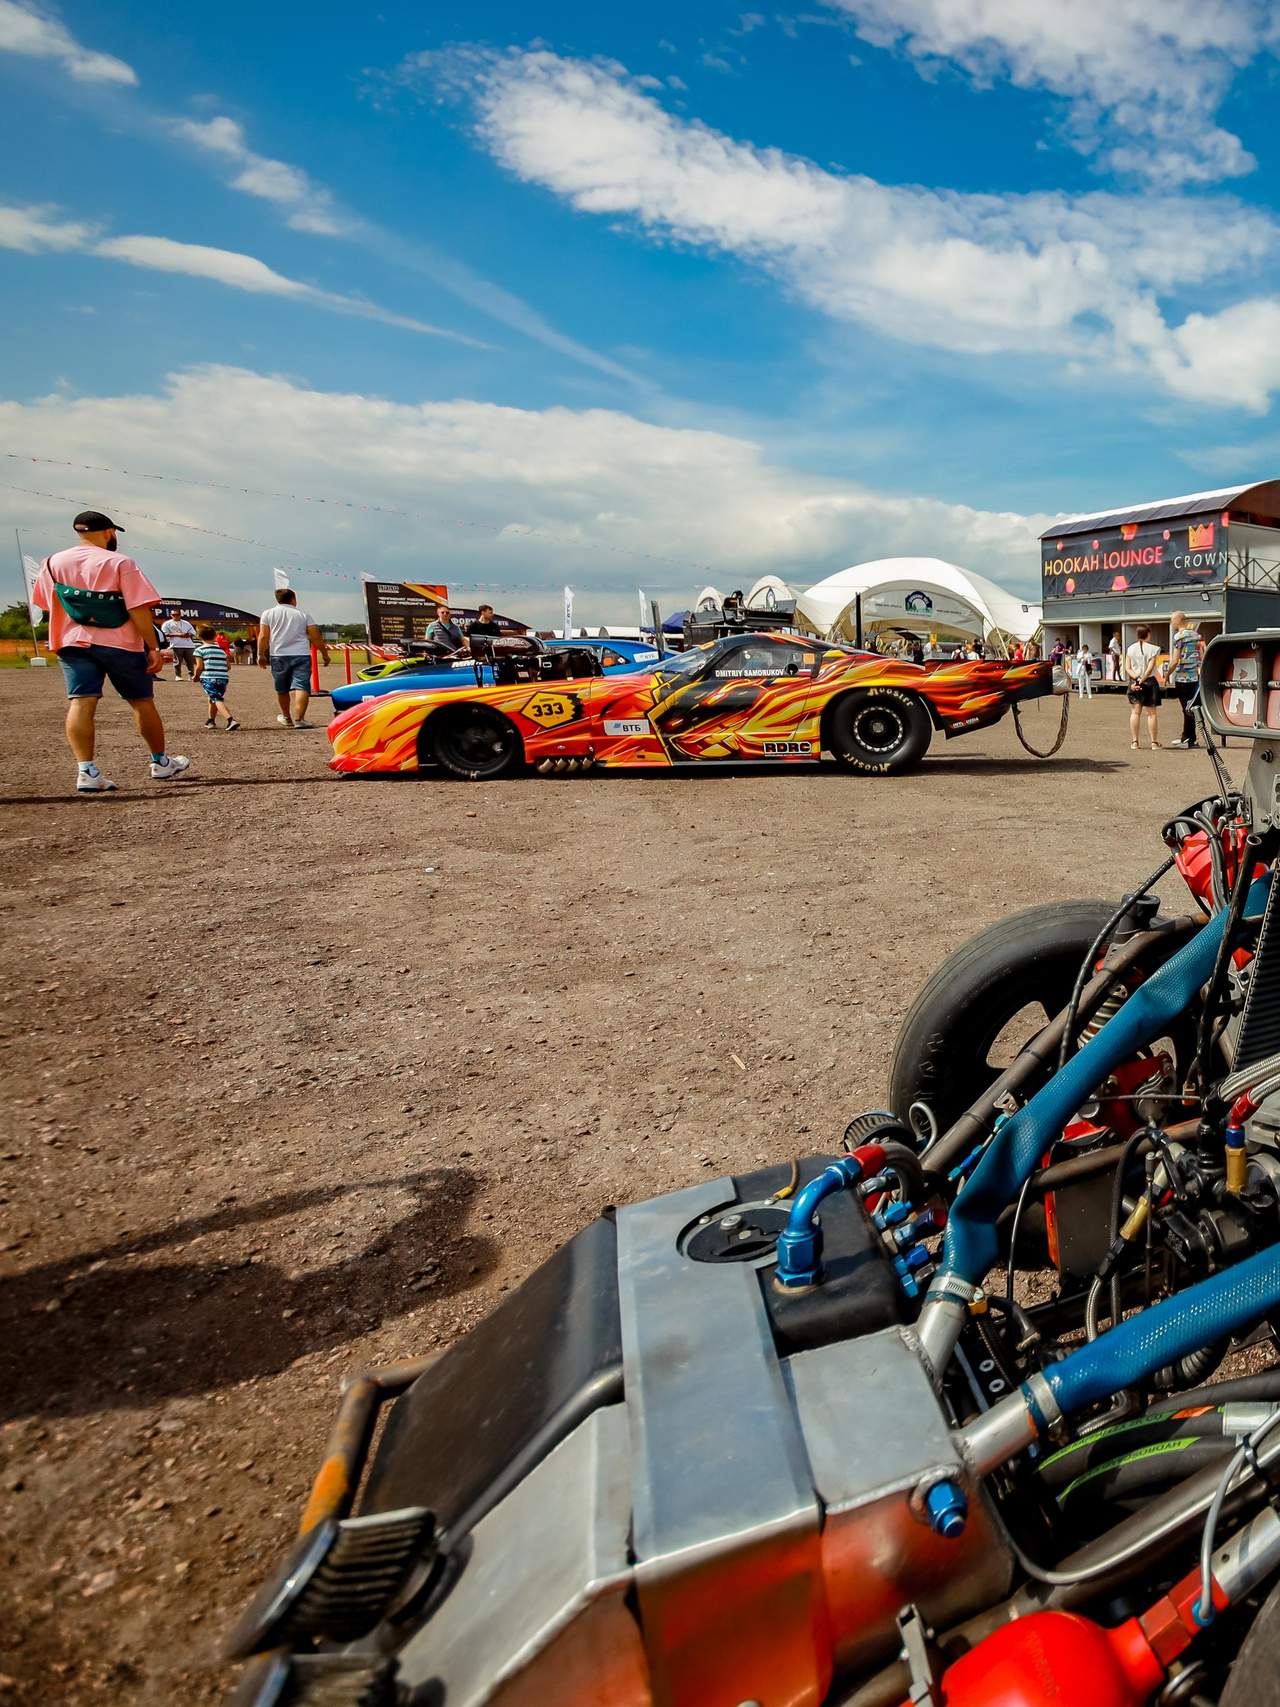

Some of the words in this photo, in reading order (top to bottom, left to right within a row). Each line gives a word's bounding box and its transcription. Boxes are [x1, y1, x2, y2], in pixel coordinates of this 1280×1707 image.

[1044, 554, 1099, 577] HOOKAH
[1103, 546, 1163, 570] LOUNGE
[1173, 550, 1228, 569] CROWN
[715, 669, 742, 677] DMITRIY
[743, 669, 784, 677] SAMORUKOV
[531, 702, 564, 717] 333
[622, 724, 641, 732] ВТБ
[764, 741, 811, 754] RDRC
